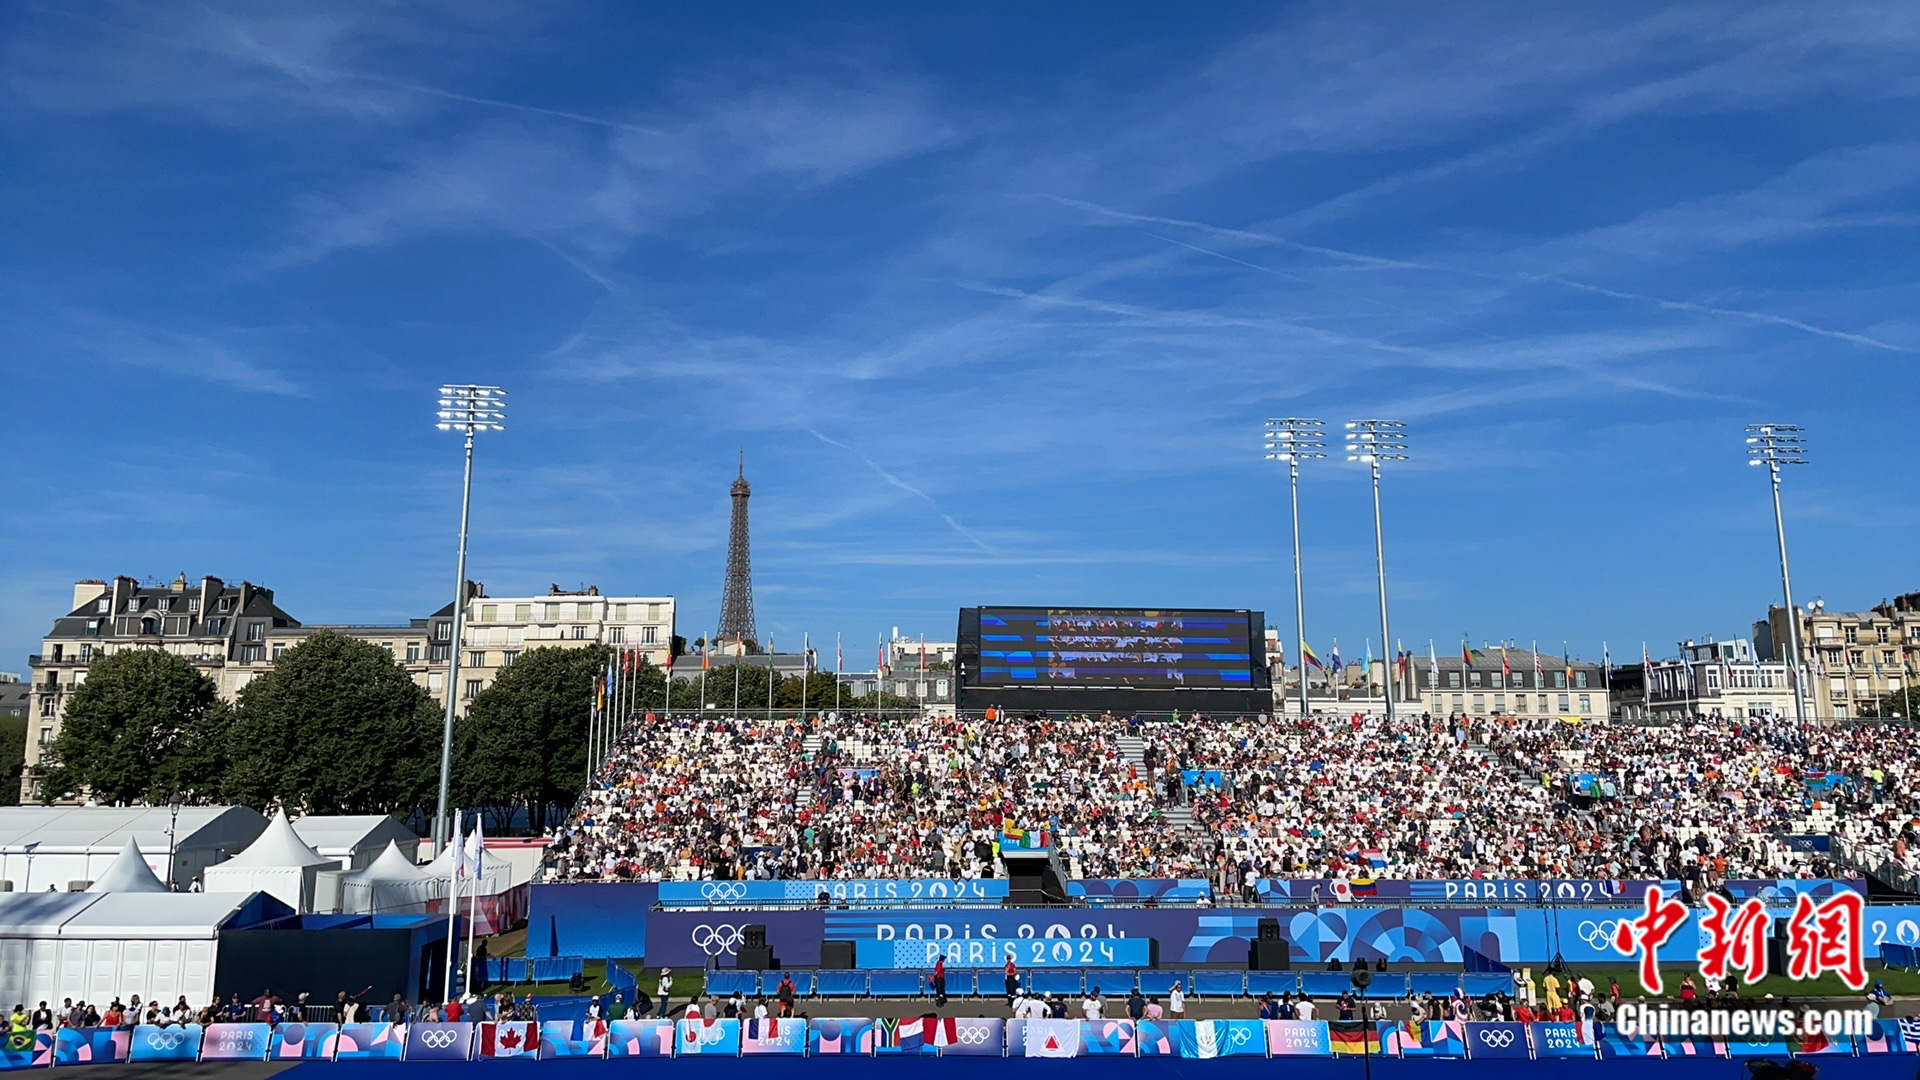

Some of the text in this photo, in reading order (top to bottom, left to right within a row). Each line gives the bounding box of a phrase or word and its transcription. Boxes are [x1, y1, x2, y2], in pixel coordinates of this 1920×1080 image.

[910, 882, 985, 901] 2024
[1031, 941, 1114, 963] 2024
[218, 1041, 252, 1051] 2024
[758, 1036, 791, 1046] 2024
[1285, 1038, 1318, 1048] 2024
[1547, 1038, 1580, 1049] 2024
